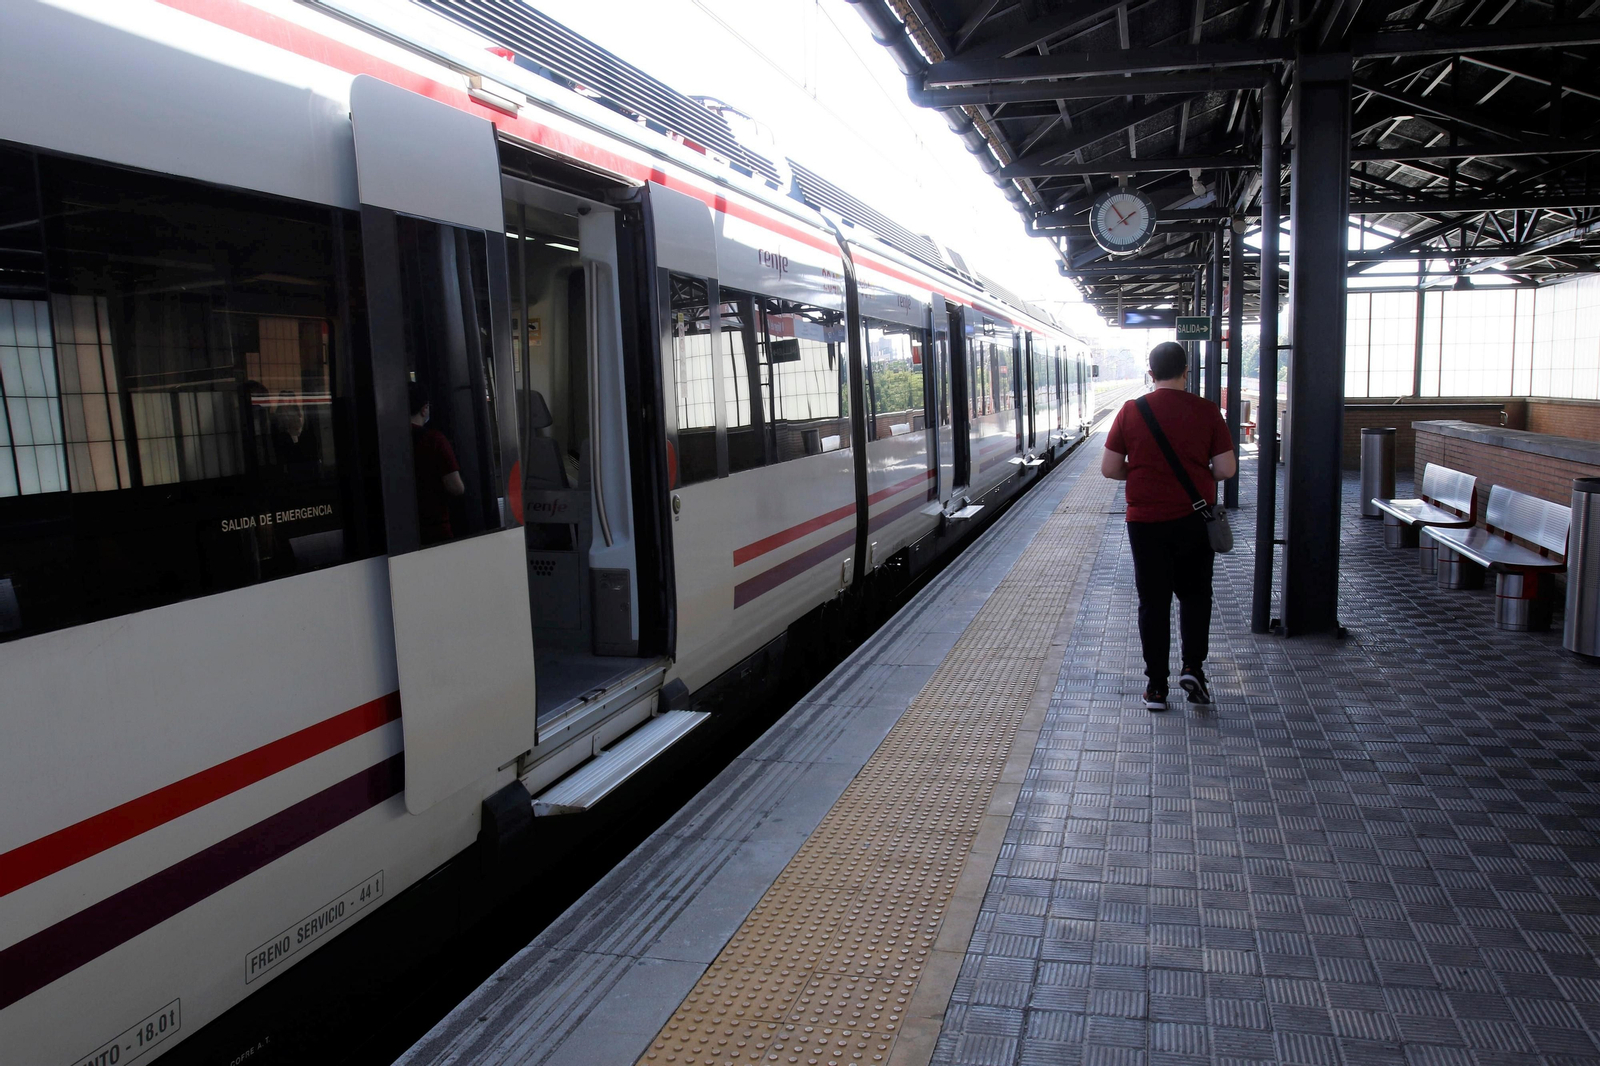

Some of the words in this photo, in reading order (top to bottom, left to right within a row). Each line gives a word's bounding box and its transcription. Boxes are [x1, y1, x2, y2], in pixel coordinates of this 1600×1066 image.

[758, 245, 789, 281] renfe
[1177, 324, 1200, 333] SALIDA
[221, 516, 257, 532] SALIDA
[259, 513, 273, 526] DE
[275, 504, 333, 523] EMERGENCIA
[526, 499, 568, 517] renfe
[251, 936, 290, 974] FRENO
[297, 901, 345, 944] SERVICIO
[359, 884, 371, 902] 44
[230, 1047, 255, 1066] COFRE
